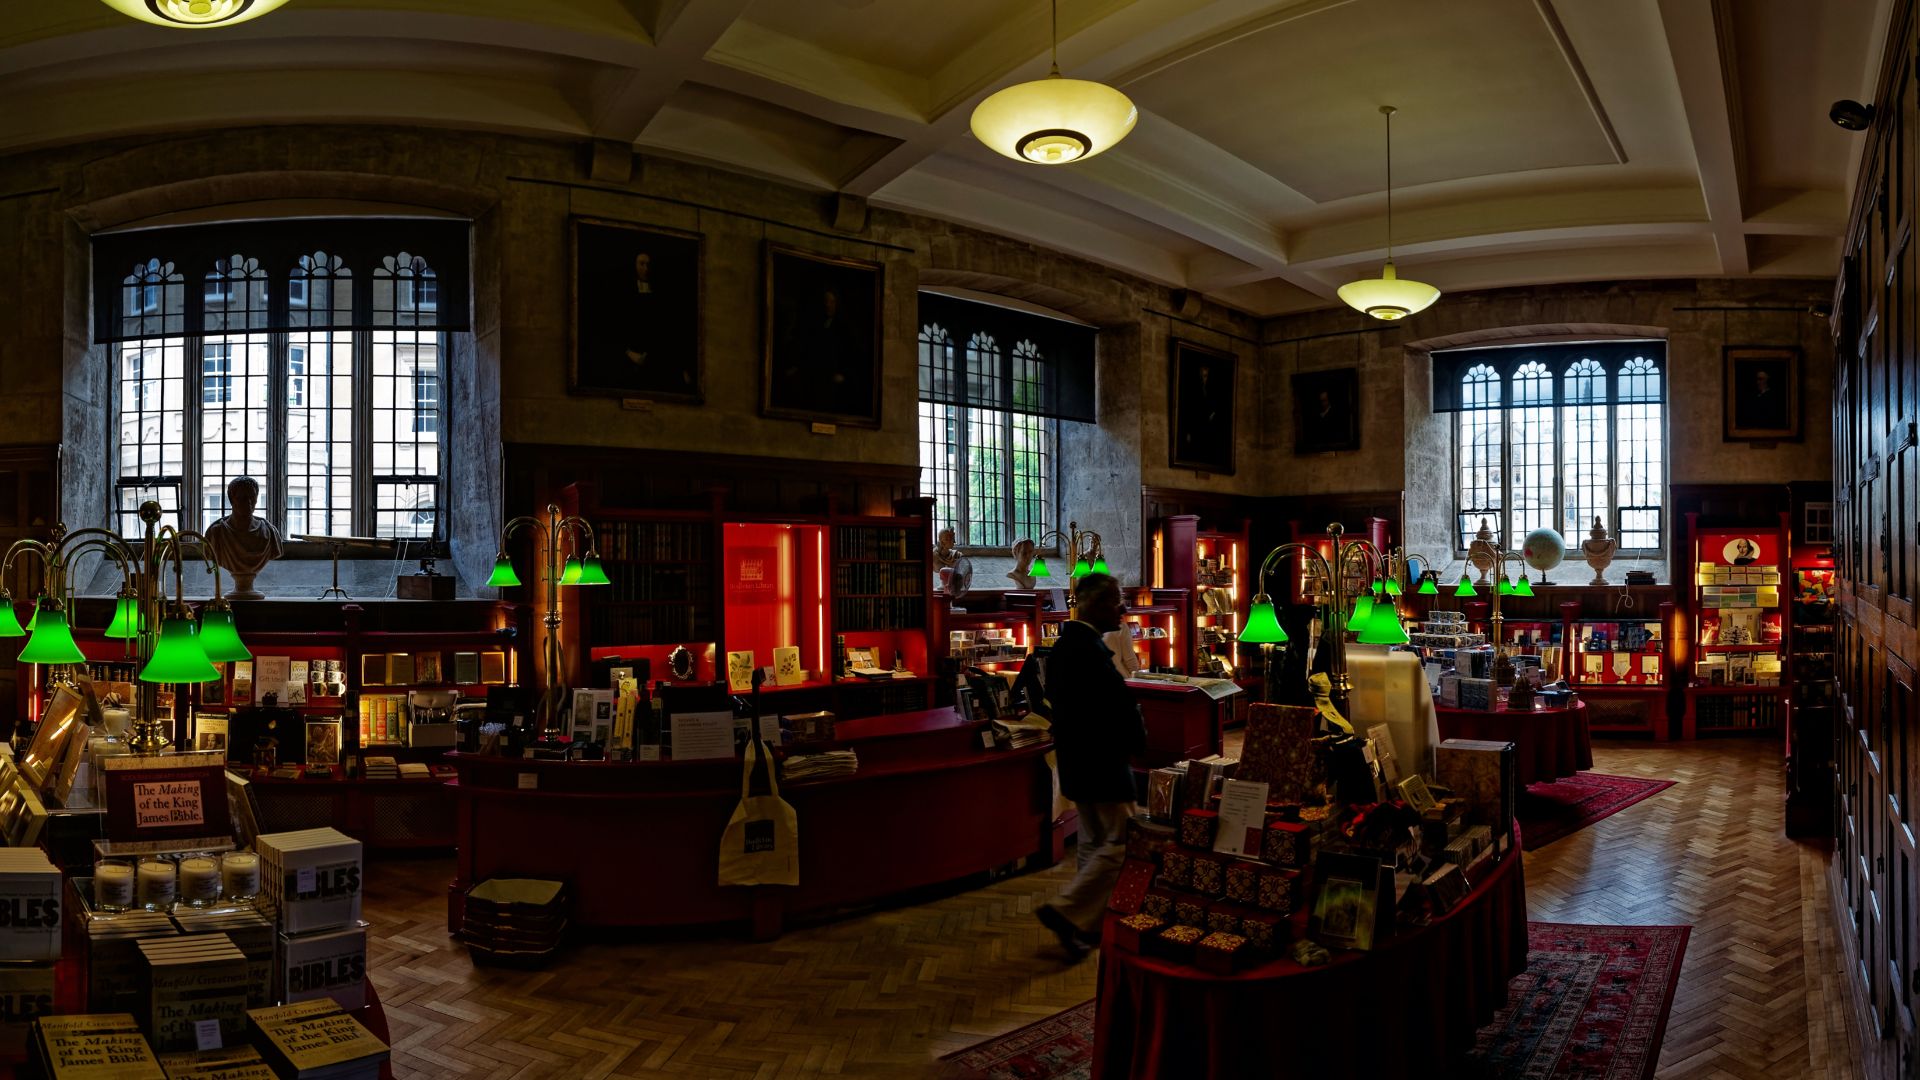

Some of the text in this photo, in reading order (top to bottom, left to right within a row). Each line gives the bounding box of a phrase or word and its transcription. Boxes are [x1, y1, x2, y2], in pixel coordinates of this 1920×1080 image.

[136, 783, 200, 798] The Making
[138, 797, 199, 810] of the King
[137, 811, 169, 826] James
[288, 955, 364, 993] BIBLES
[0, 994, 52, 1023] LES
[157, 1005, 184, 1018] The
[161, 1019, 178, 1033] of
[179, 1018, 194, 1032] th
[273, 1016, 354, 1037] The Making
[55, 1036, 142, 1047] The Making
[282, 1024, 357, 1045] of the King
[58, 1045, 144, 1058] of the King
[286, 1040, 329, 1055] James
[59, 1053, 148, 1068] James Bible
